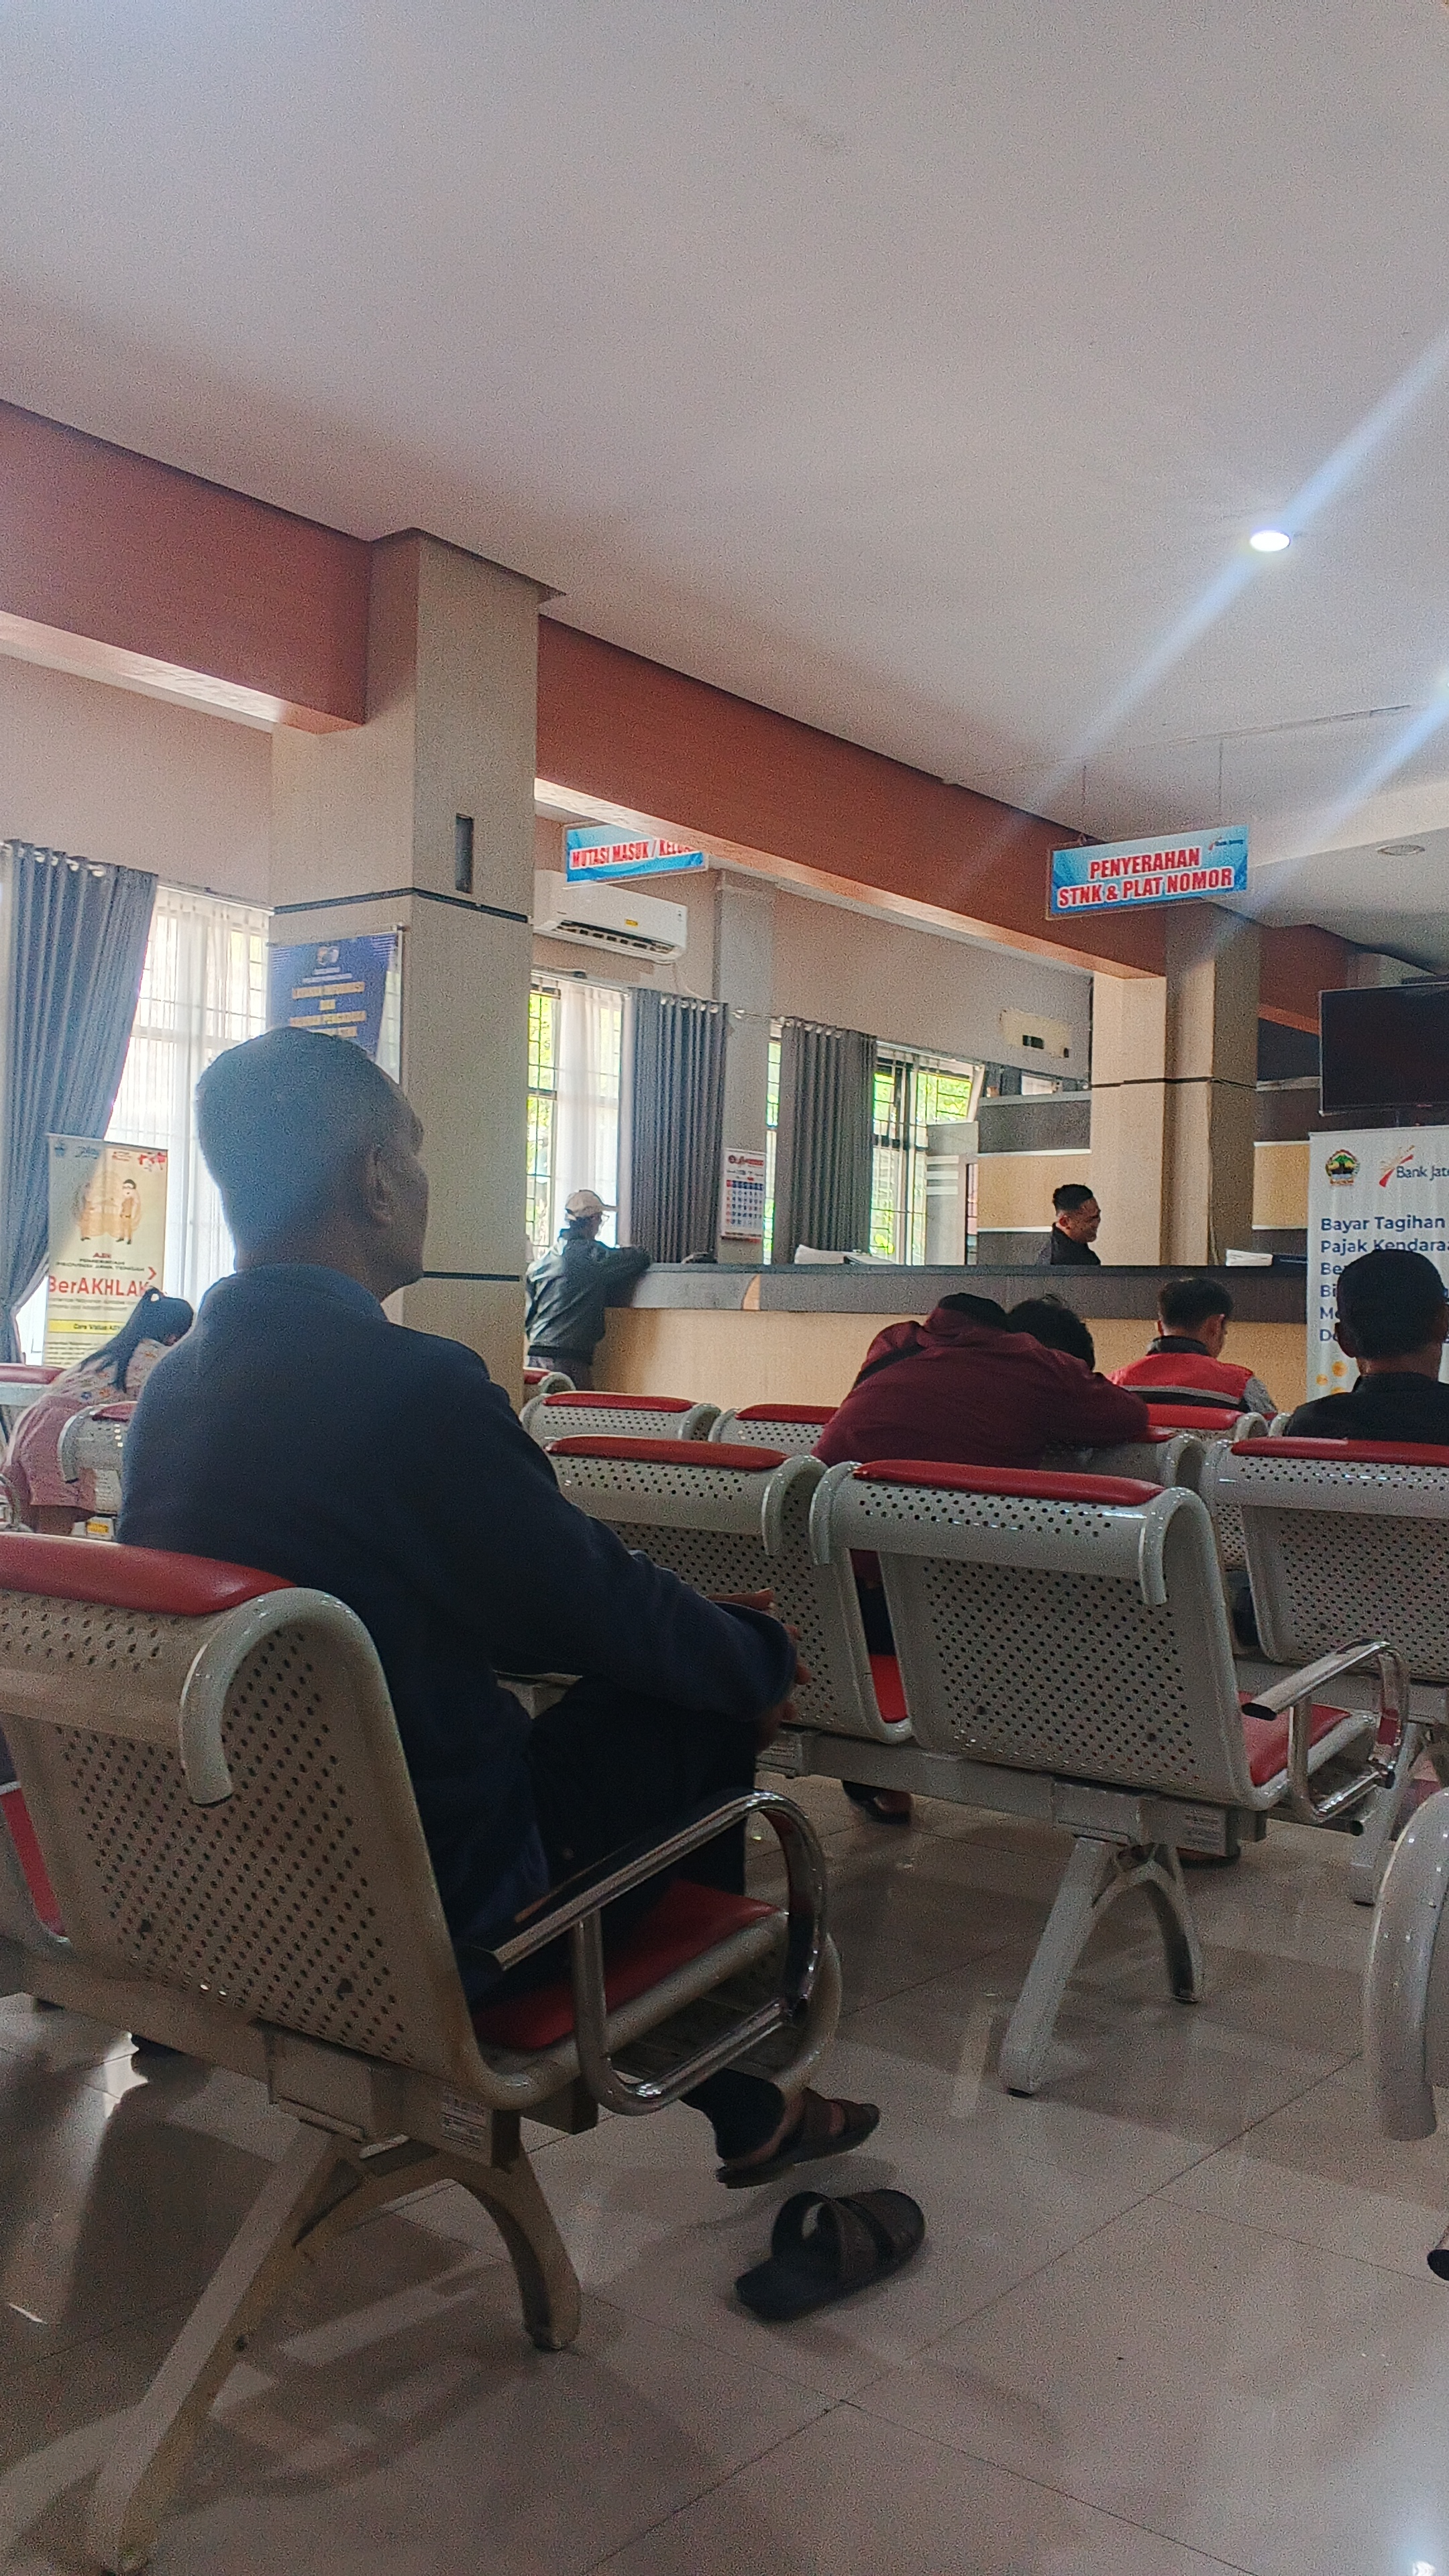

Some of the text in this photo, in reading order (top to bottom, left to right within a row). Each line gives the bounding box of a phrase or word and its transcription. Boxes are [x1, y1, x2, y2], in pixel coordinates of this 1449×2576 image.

[573, 848, 608, 867] MUTASI
[613, 842, 649, 862] MASUK
[1090, 847, 1201, 879] PENYERAHAN
[1059, 868, 1233, 907] STNK & PLAT NOMOR
[1396, 1165, 1449, 1181] Bank Jat
[1321, 1214, 1446, 1234] Bayar Tagihan
[1321, 1238, 1449, 1256] Pajak Kendara
[48, 1275, 149, 1297] BerAKHLAK
